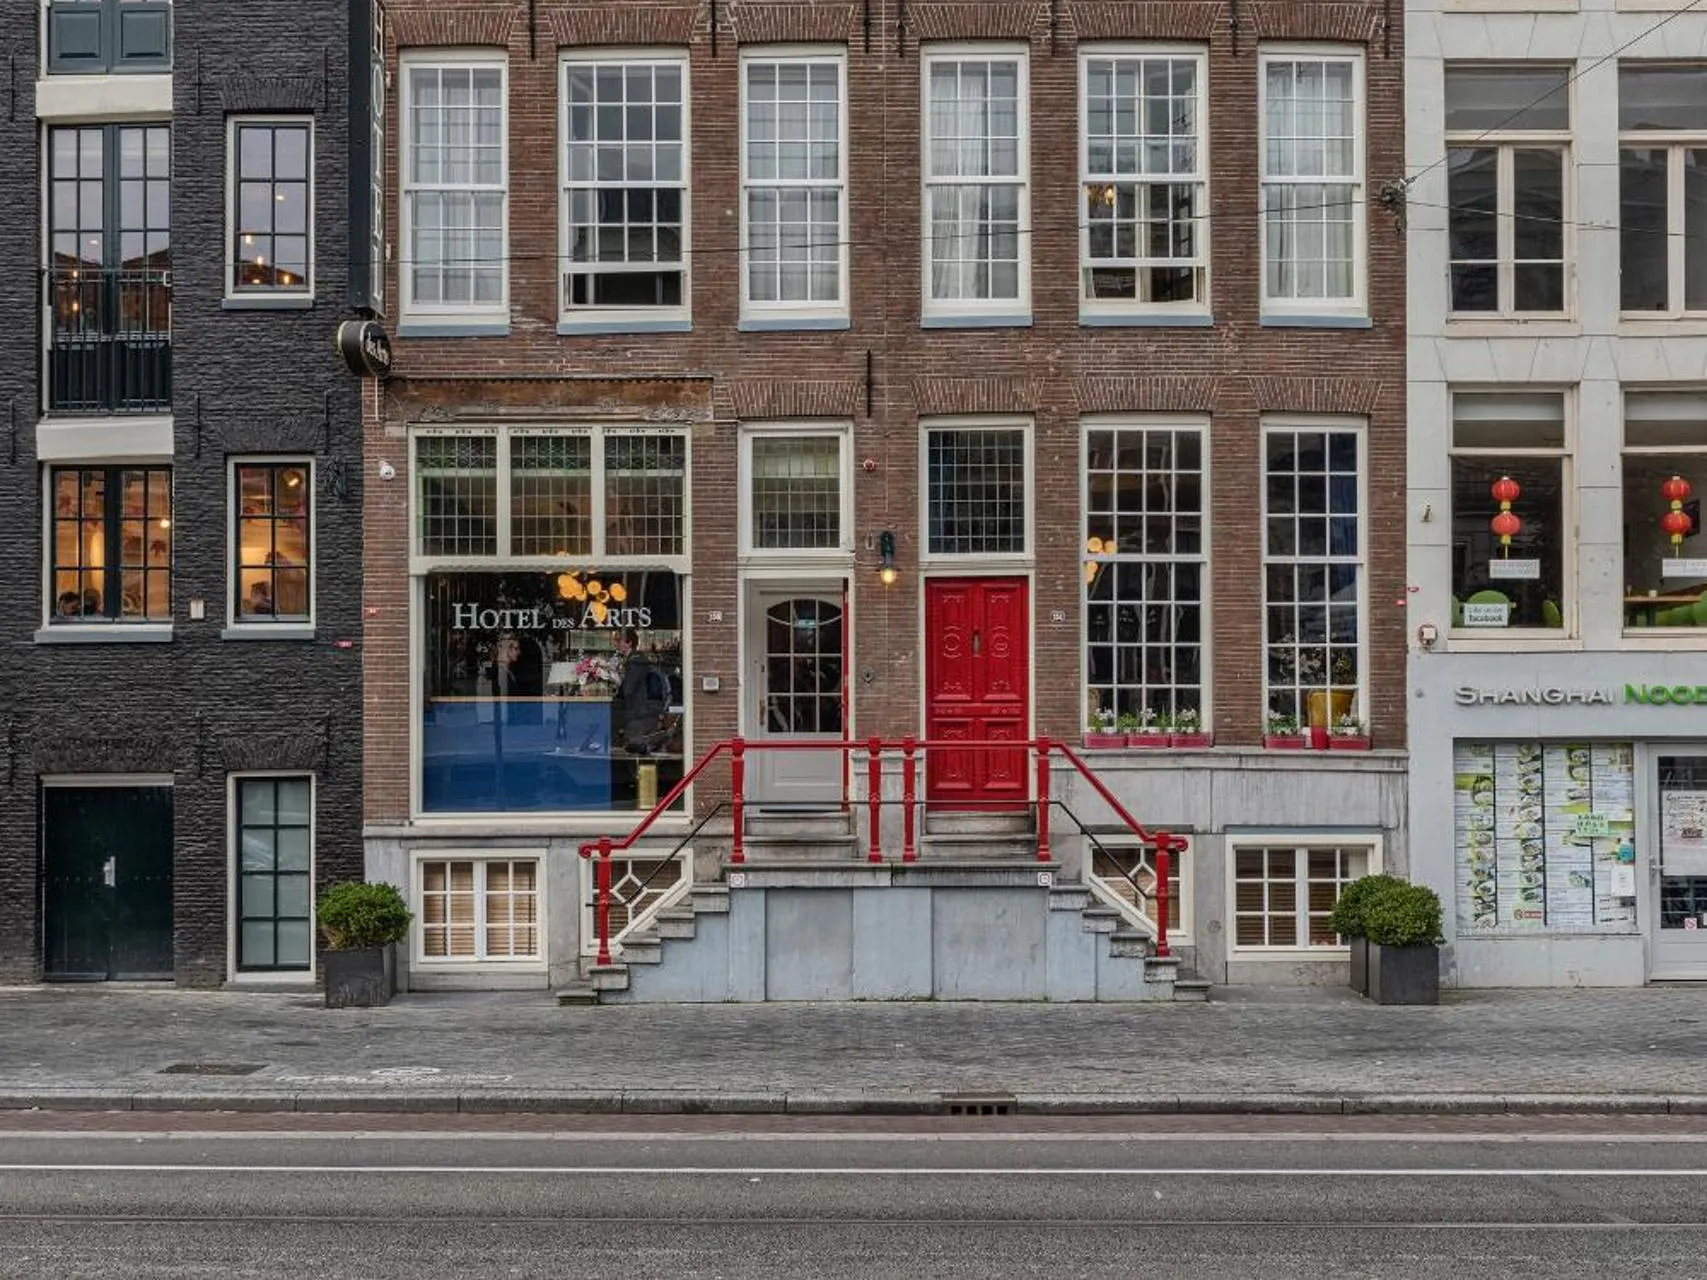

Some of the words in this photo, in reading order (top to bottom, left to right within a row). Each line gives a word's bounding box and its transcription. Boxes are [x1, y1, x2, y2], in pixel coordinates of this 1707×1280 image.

[452, 602, 547, 629] HOTEL
[552, 618, 576, 629] DES
[578, 600, 652, 628] ARTS
[1456, 687, 1613, 705] SHANGHAI
